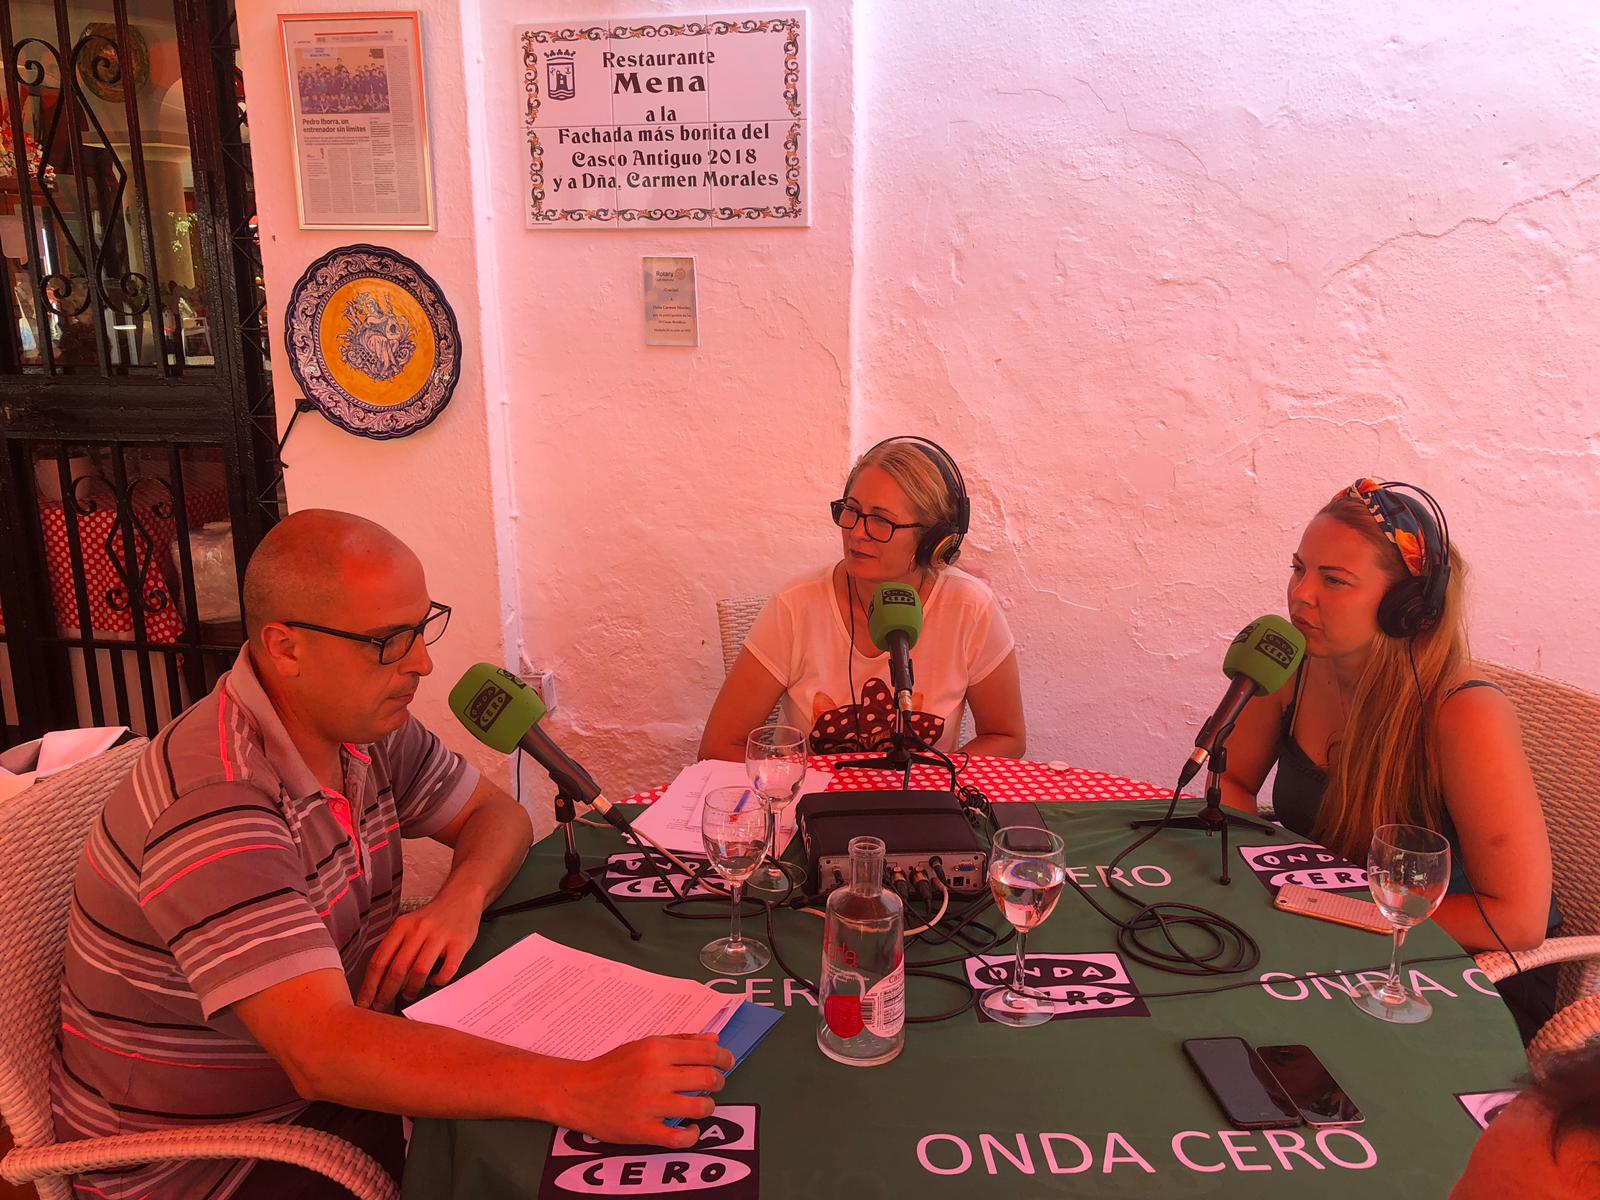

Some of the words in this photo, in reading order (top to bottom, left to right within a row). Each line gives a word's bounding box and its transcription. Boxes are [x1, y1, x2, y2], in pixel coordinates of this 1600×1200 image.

[602, 50, 715, 68] Restaurante
[613, 72, 707, 95] Mena
[645, 109, 656, 123] a
[661, 105, 677, 122] la
[558, 126, 633, 145] Fachada
[638, 124, 675, 143] más
[680, 123, 737, 142] bonita
[741, 122, 770, 141] del
[571, 150, 628, 168] Casco
[632, 149, 703, 169] Antiguo
[707, 148, 757, 166] 2018
[552, 174, 563, 192] y
[568, 176, 578, 190] a
[581, 173, 623, 191] Dña.
[626, 171, 698, 188] Carmen
[703, 169, 779, 187] Morales
[1264, 644, 1288, 662] CERO
[472, 688, 494, 716] ONDA
[482, 696, 504, 722] CERO
[1262, 853, 1349, 865] OND
[1064, 865, 1173, 888] ERO
[704, 978, 820, 1007] CER
[915, 1131, 1157, 1175] ONDA
[1170, 1129, 1379, 1172] CERO
[582, 1160, 727, 1186] CERO
